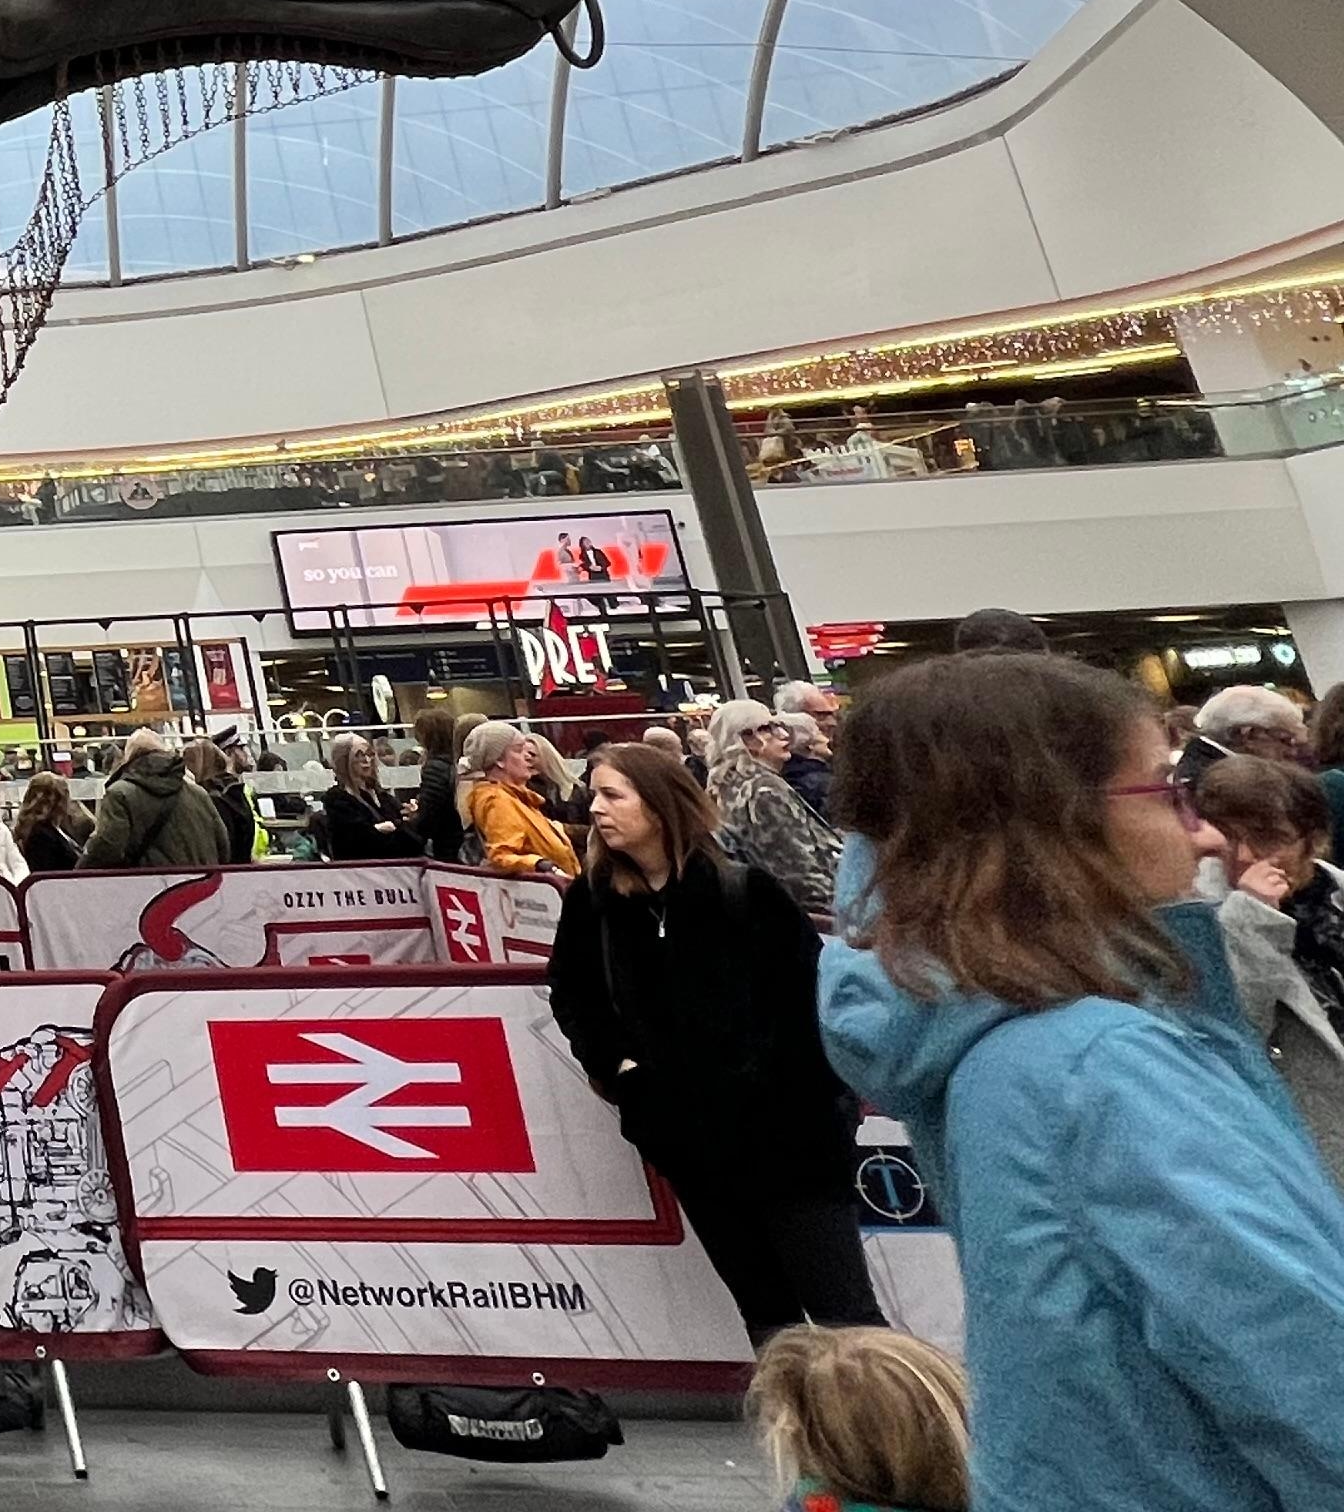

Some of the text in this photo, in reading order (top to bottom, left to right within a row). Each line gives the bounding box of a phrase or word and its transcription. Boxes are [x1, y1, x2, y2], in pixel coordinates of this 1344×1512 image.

[302, 565, 399, 585] so you can
[515, 623, 614, 687] PRET
[282, 887, 419, 909] OZZY THE BULL
[287, 1277, 587, 1312] @NetworkRailBHM
